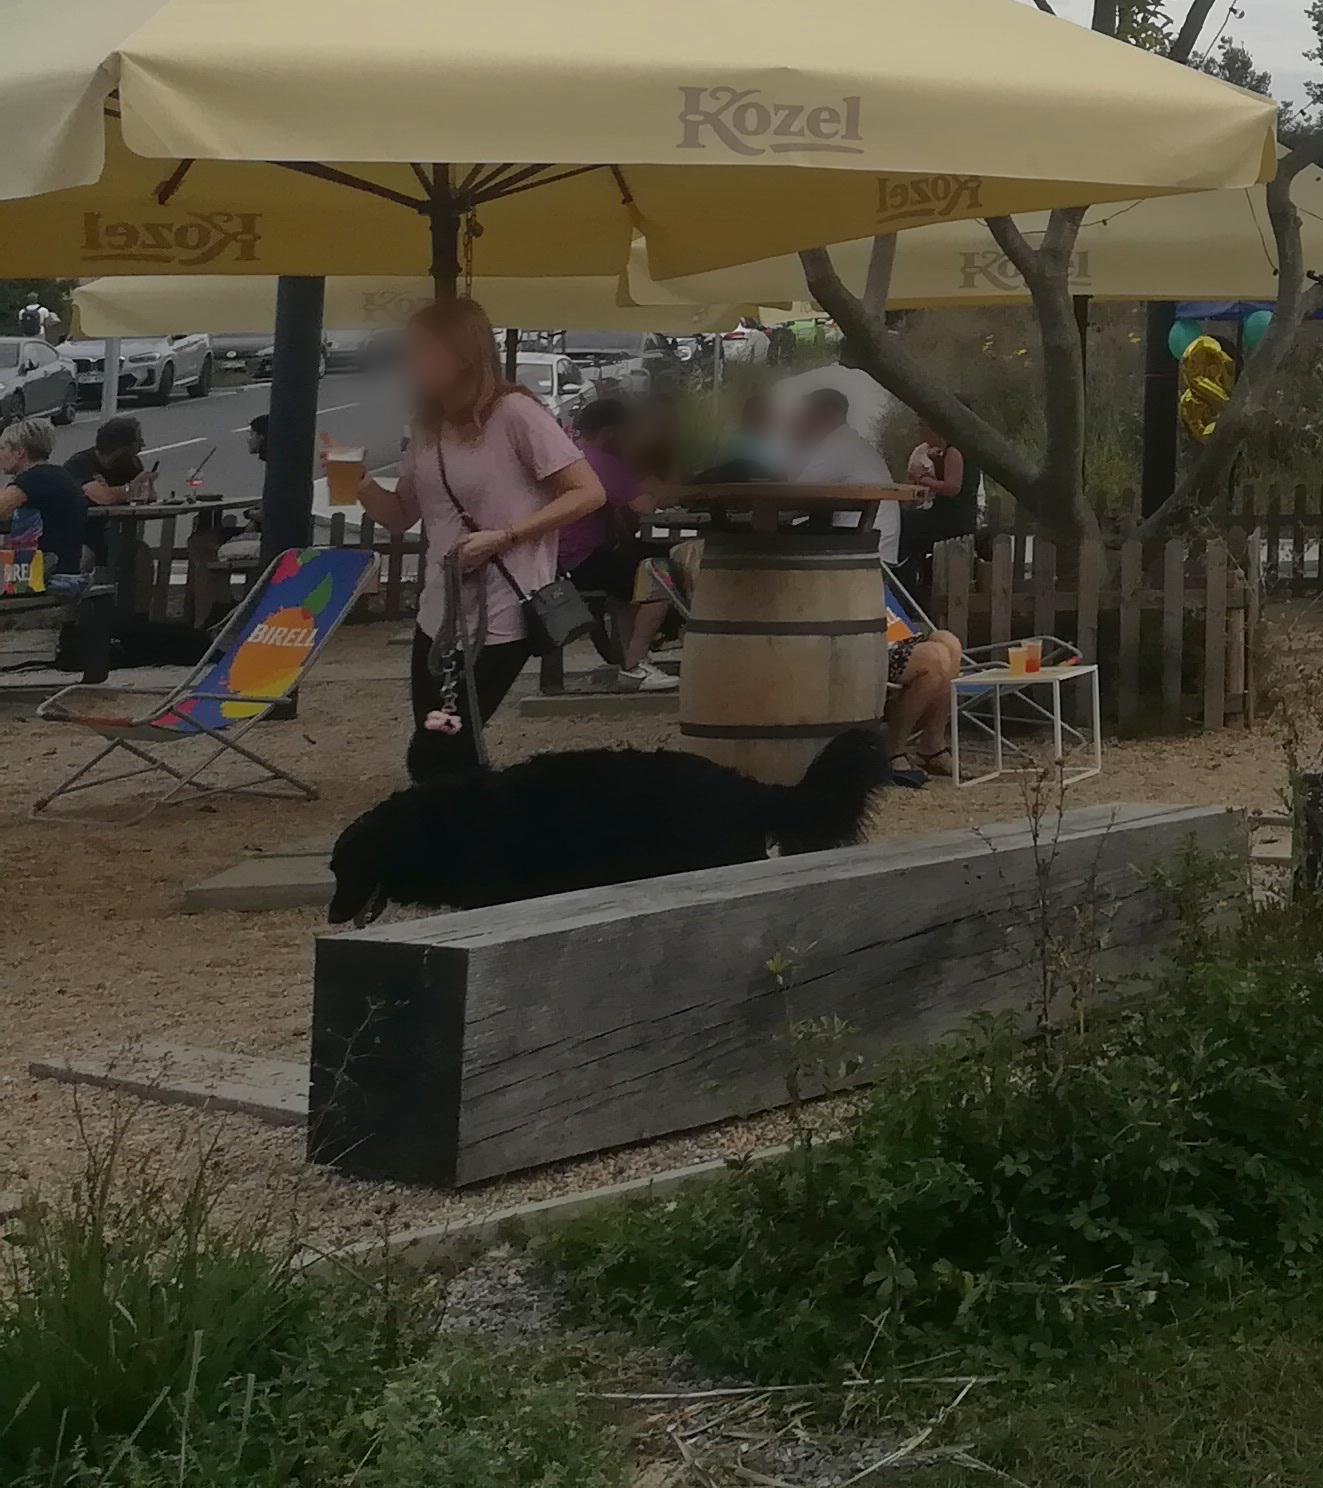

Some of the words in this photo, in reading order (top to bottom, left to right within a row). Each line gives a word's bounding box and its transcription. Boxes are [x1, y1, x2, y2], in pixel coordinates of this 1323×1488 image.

[675, 86, 865, 157] Kozel
[959, 250, 1091, 290] Kol
[247, 623, 319, 647] BIRELL
